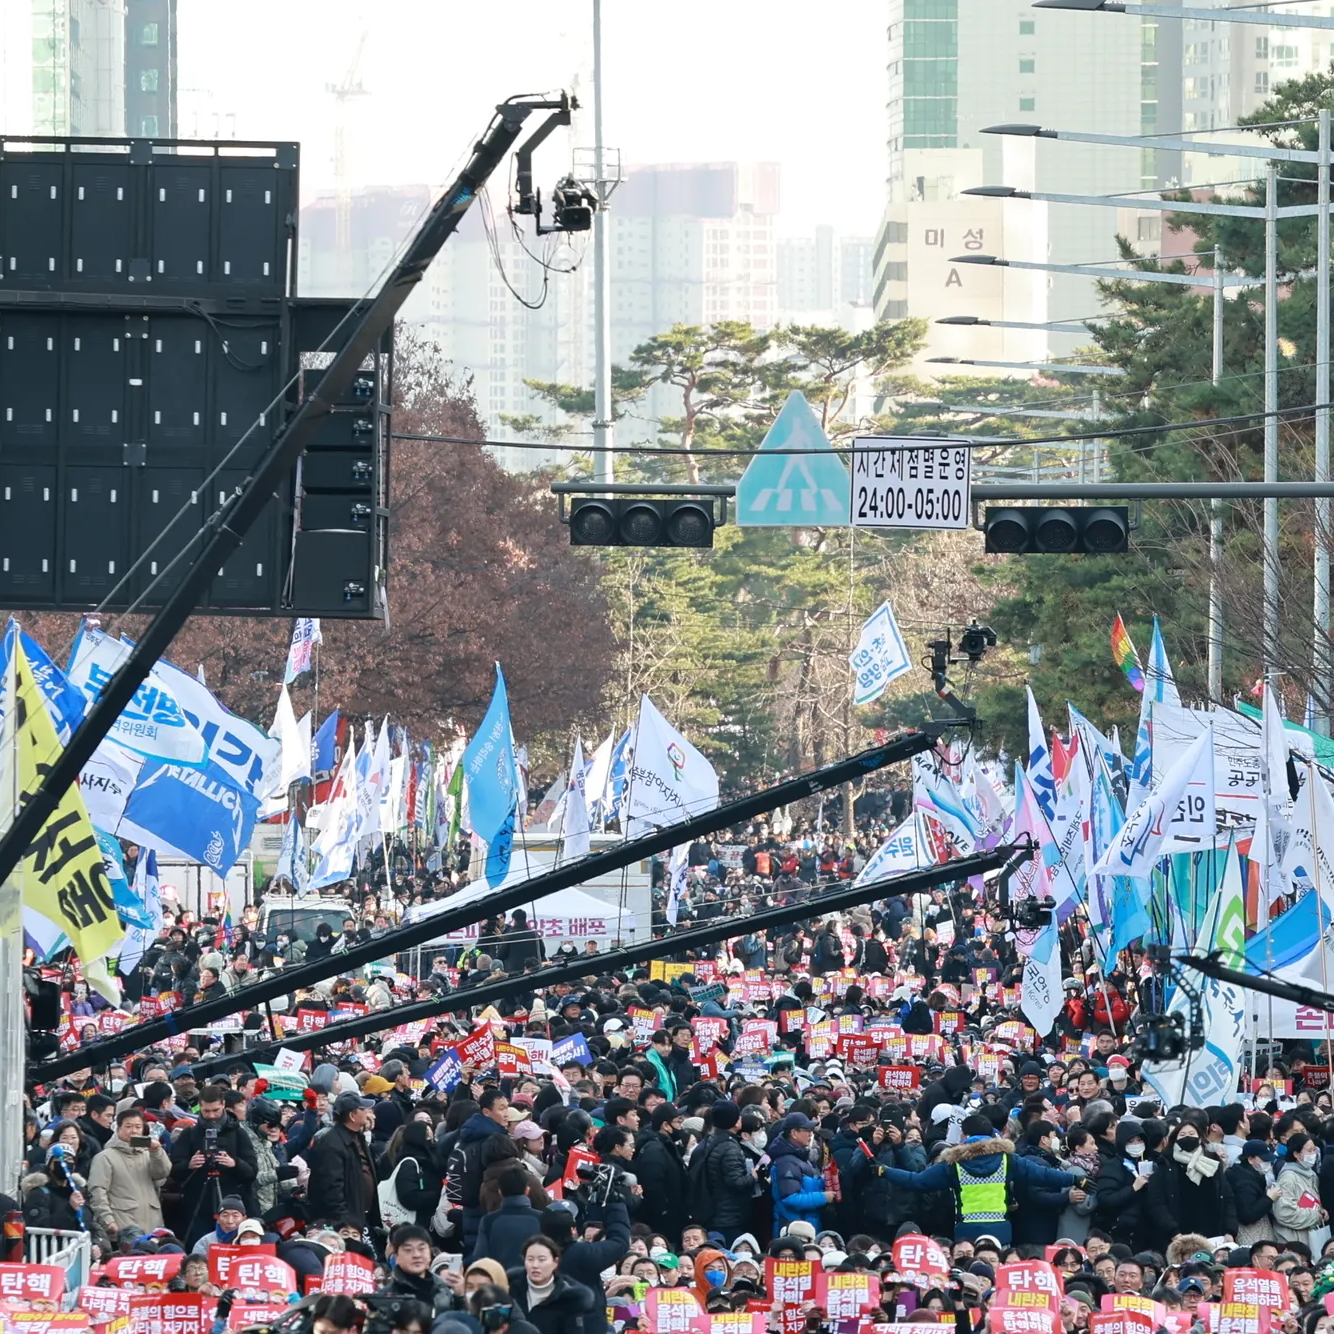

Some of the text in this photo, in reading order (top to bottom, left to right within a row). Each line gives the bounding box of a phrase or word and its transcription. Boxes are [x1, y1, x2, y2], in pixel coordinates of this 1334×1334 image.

[857, 486, 962, 521] 24:00-05:00
[900, 1244, 948, 1272] 탄핵
[117, 1259, 165, 1278] 탄핵
[773, 1261, 811, 1276] 내란죄
[238, 1266, 287, 1287] 탄핵
[773, 1276, 812, 1289] 윤석열
[827, 1274, 868, 1289] 내란죄
[1010, 1272, 1057, 1295] 탄핵
[0, 1273, 51, 1298] 탄핵
[1232, 1280, 1280, 1294] 윤석열을
[774, 1289, 804, 1303] 탄핵!
[827, 1289, 868, 1303] 윤석열
[1233, 1293, 1283, 1308] 탄핵하라
[165, 1304, 199, 1320] 힘으로
[827, 1303, 860, 1318] 탄핵!
[1220, 1303, 1260, 1318] 내란죄
[657, 1318, 690, 1332] 탄핵!
[712, 1313, 753, 1325] 내란죄
[163, 1320, 200, 1334] 지키자
